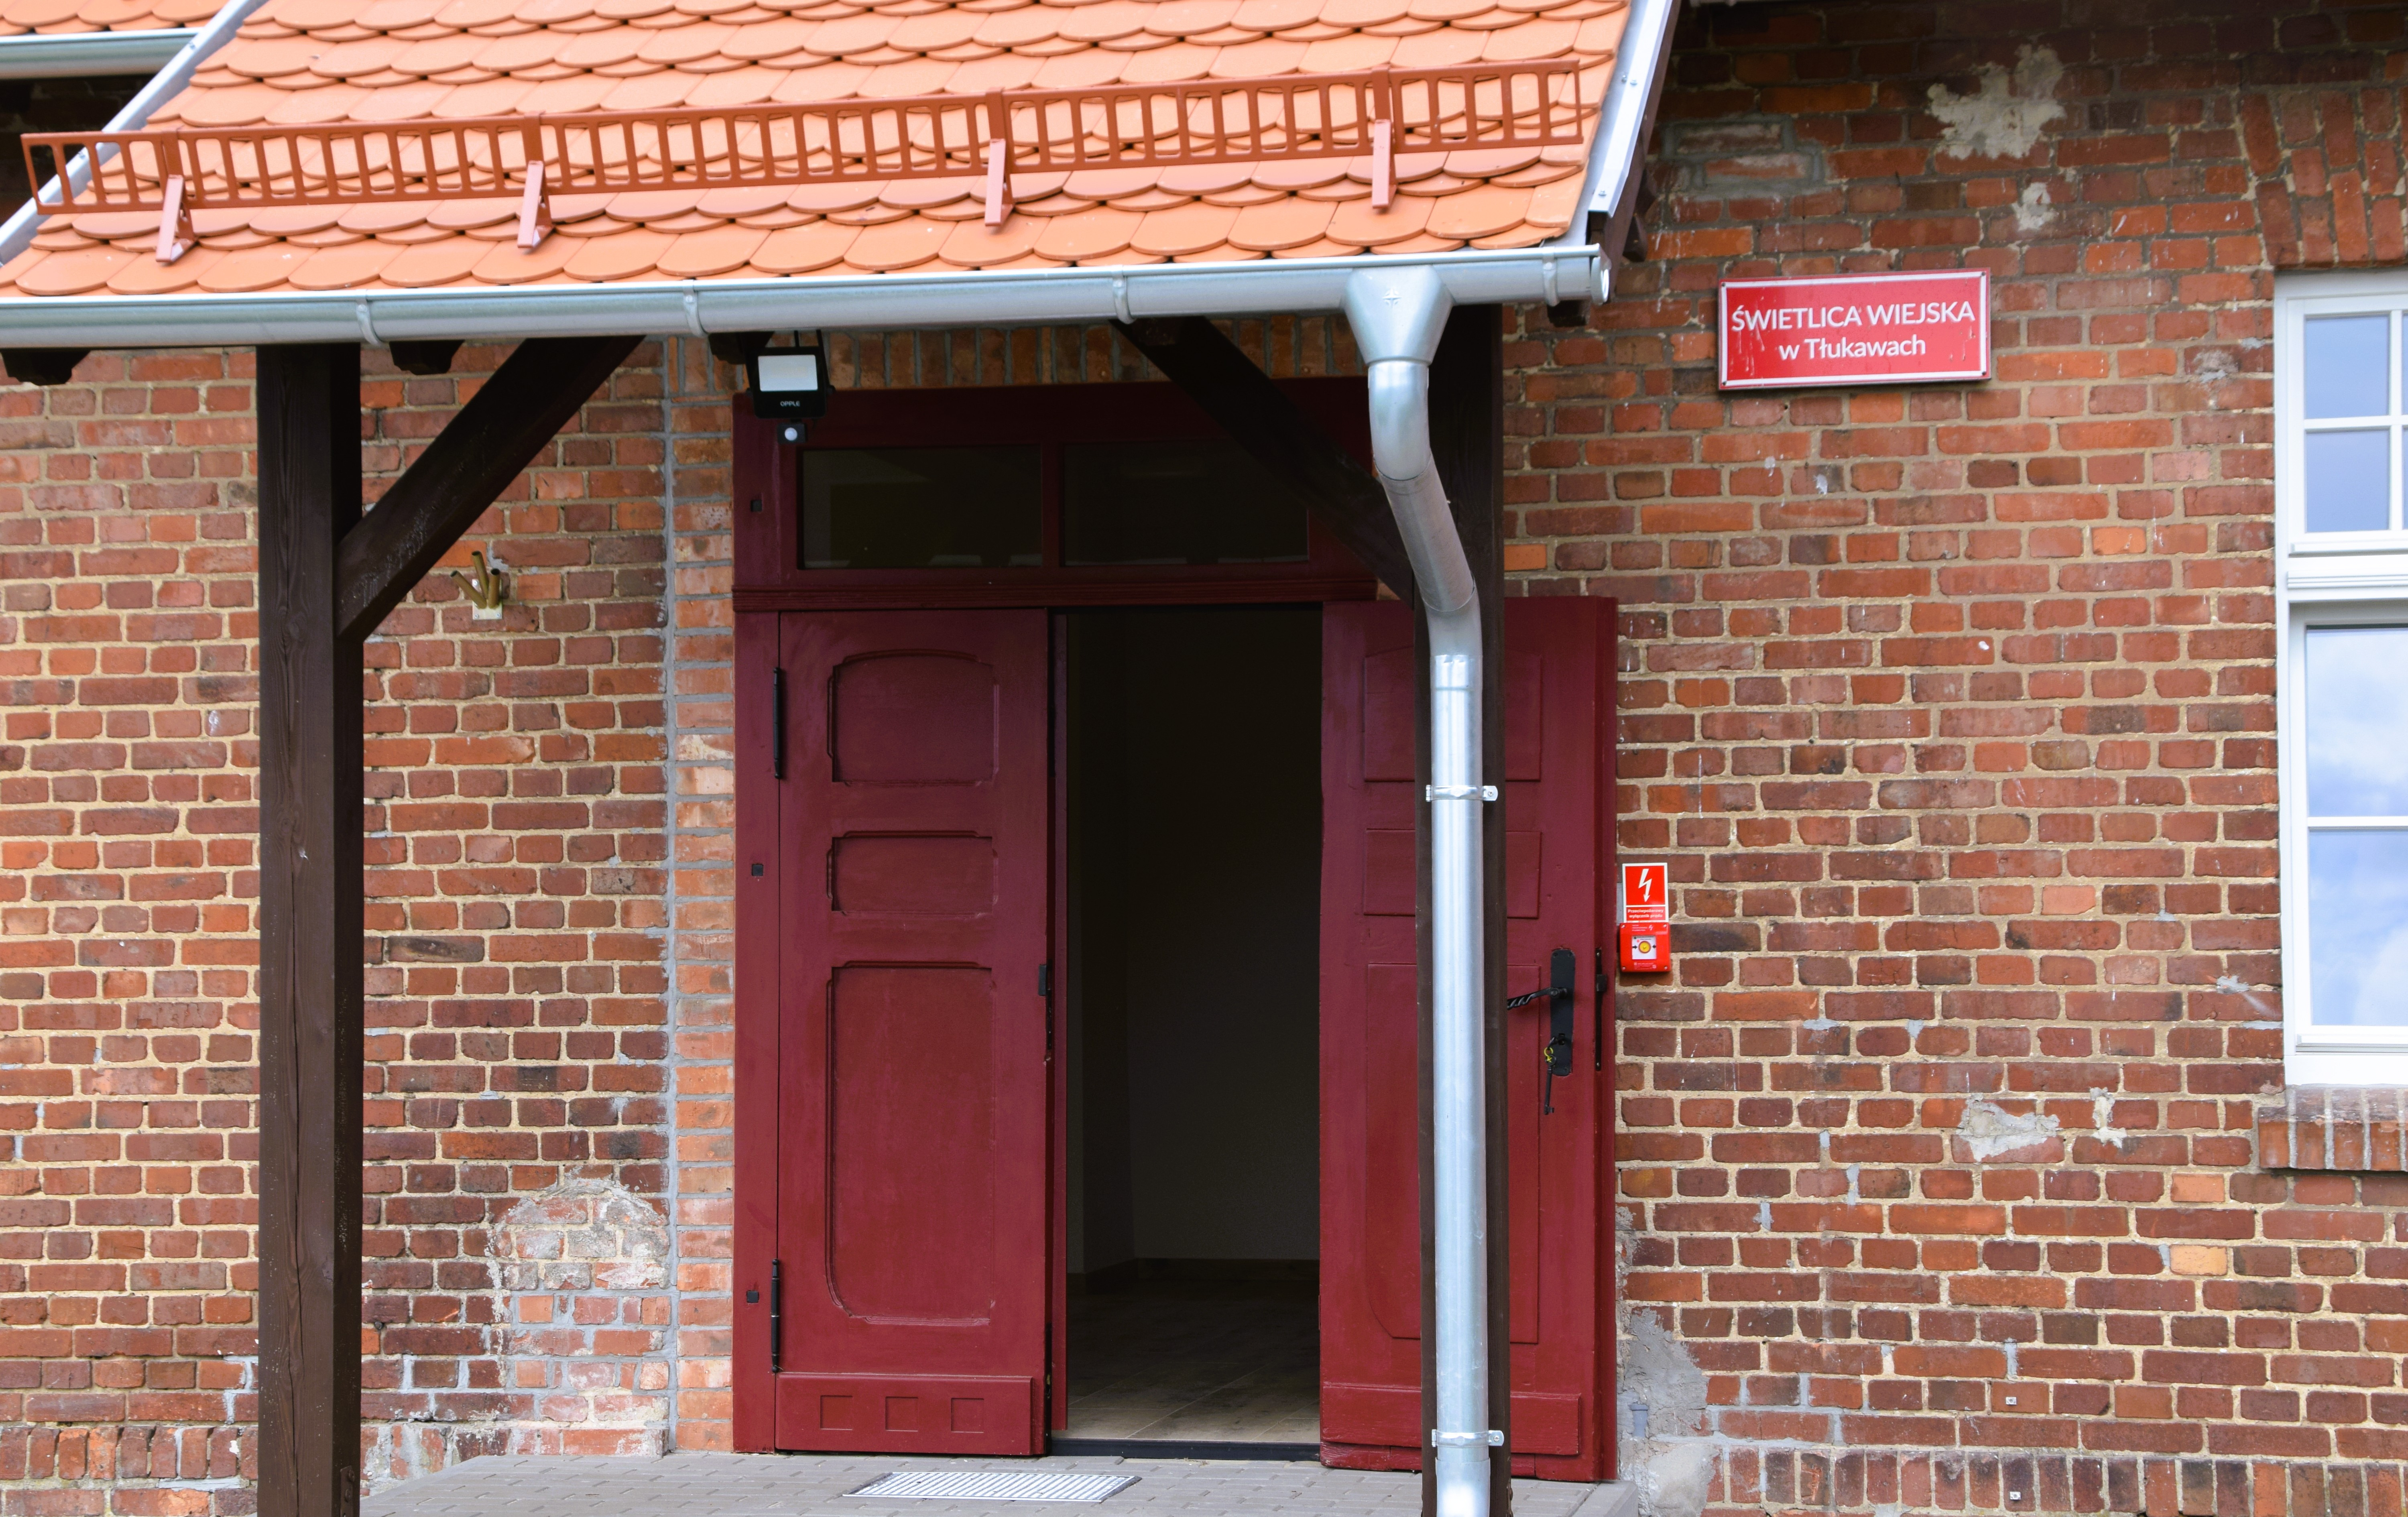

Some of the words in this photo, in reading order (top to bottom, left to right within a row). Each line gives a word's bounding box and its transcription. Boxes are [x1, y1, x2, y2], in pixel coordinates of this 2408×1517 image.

[1731, 305, 1862, 331] ŚWIETLICA
[1867, 301, 1975, 325] WIEJSKA
[1780, 344, 1800, 360] w
[1804, 334, 1926, 359] Tłukawach
